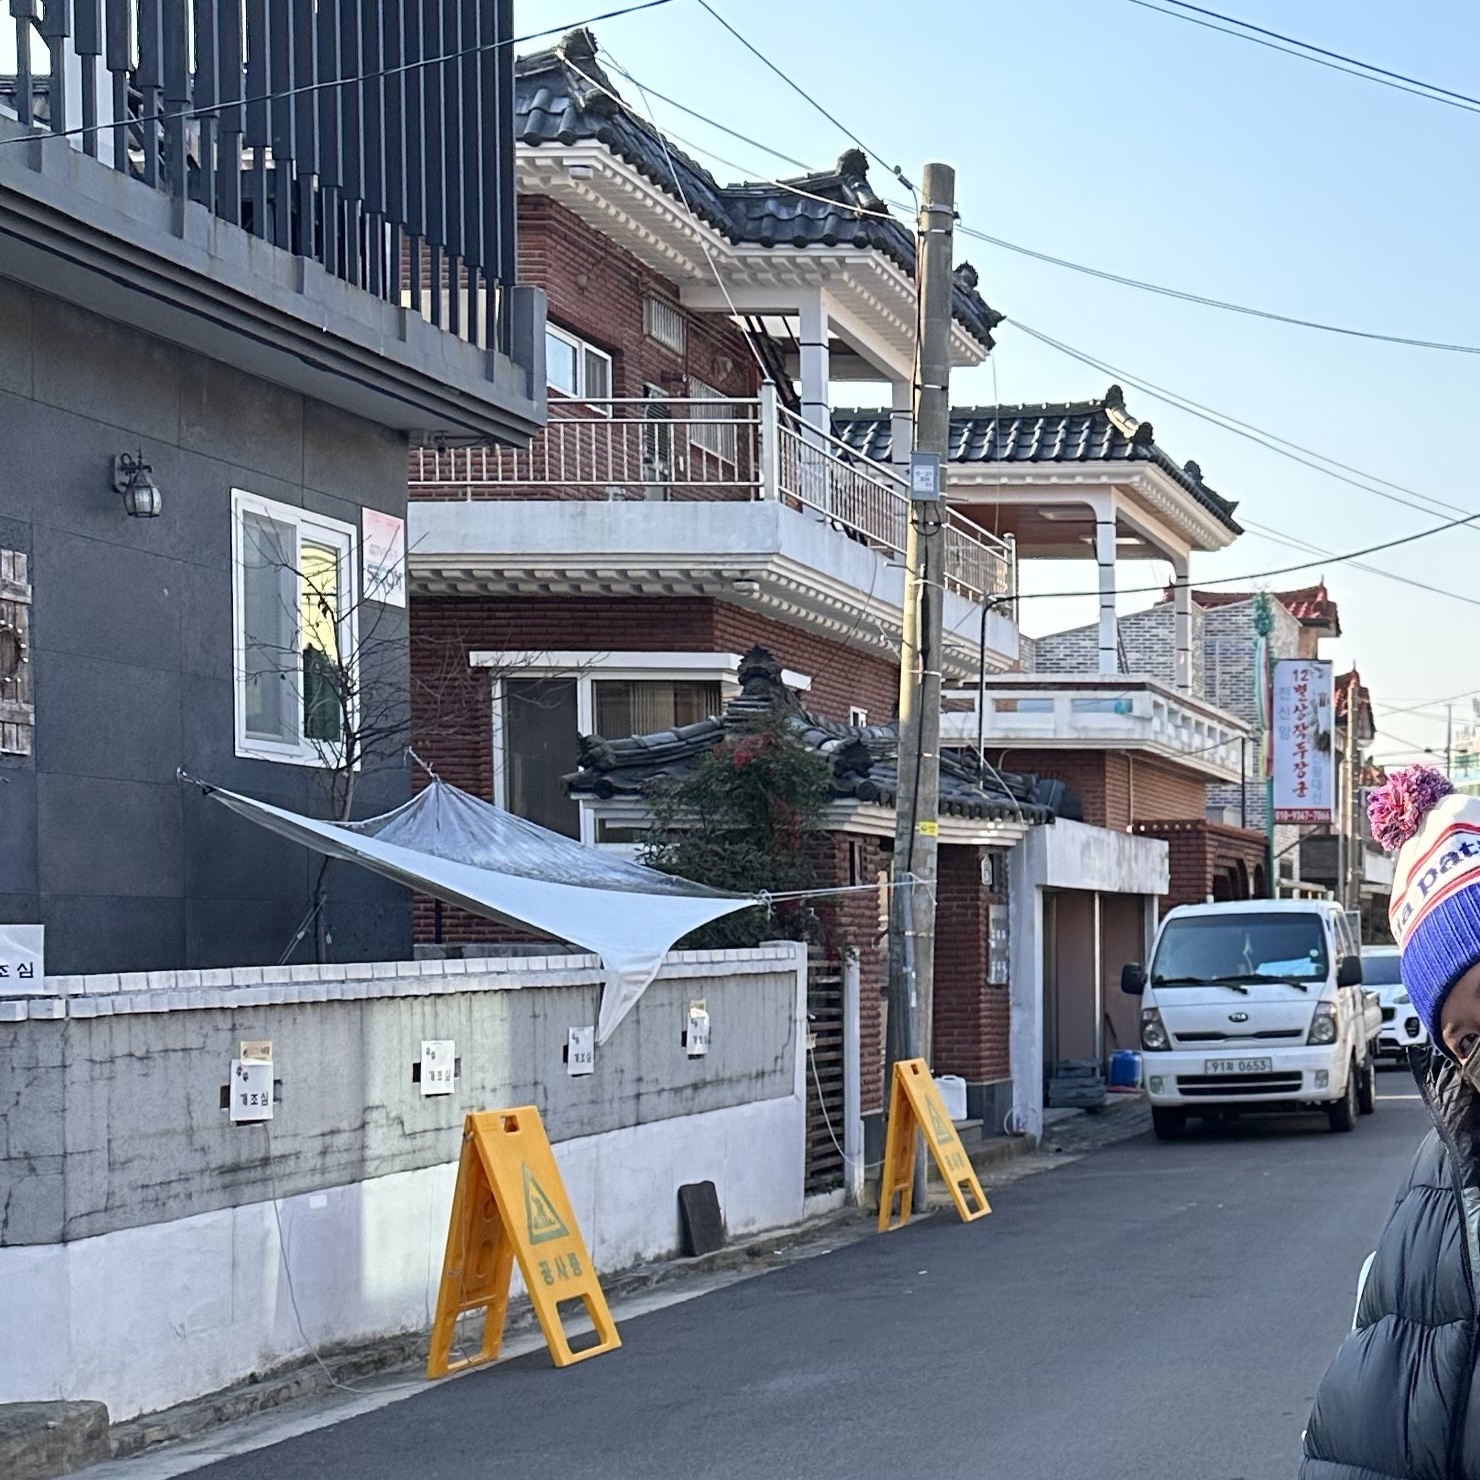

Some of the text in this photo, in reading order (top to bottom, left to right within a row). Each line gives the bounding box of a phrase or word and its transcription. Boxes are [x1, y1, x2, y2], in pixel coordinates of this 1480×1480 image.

[1238, 1060, 1266, 1071] 0653
[240, 1091, 269, 1106] 개조심
[538, 1252, 583, 1286] 공사중
